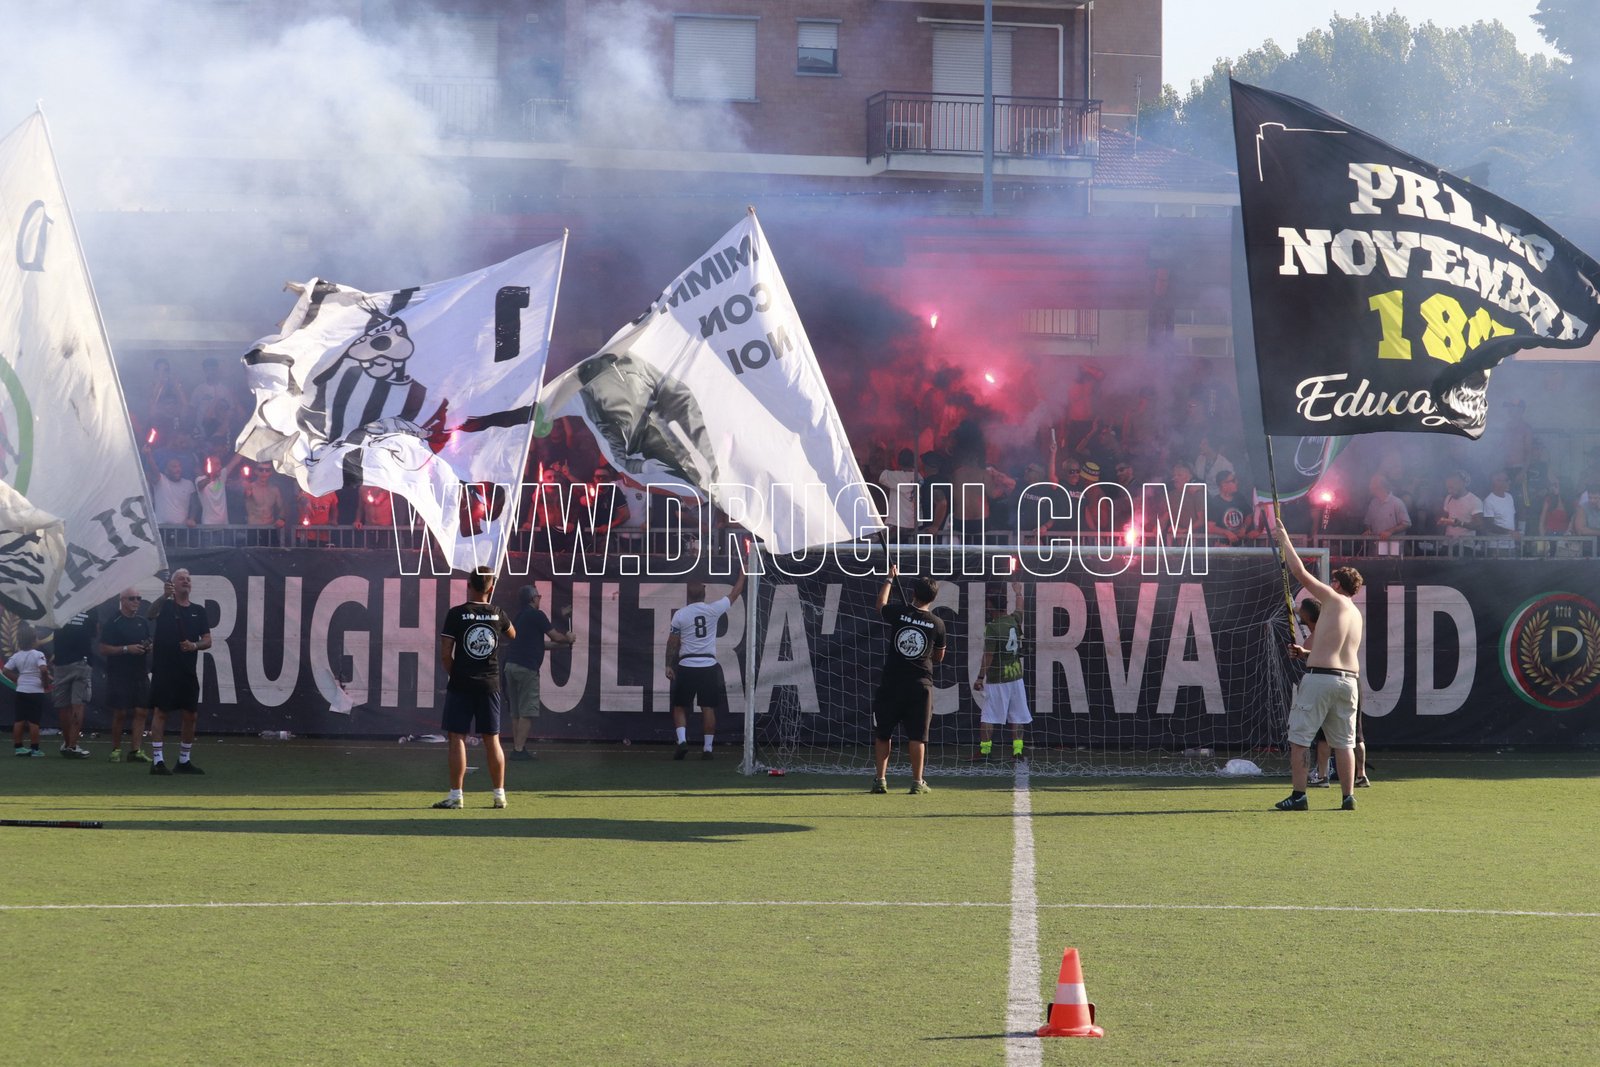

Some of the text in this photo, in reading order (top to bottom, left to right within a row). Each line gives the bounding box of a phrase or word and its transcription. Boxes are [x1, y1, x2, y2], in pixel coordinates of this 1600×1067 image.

[694, 615, 707, 639] 8
[1005, 627, 1019, 656] 4
[1294, 584, 1478, 718] UD
[1551, 625, 1584, 663] D
